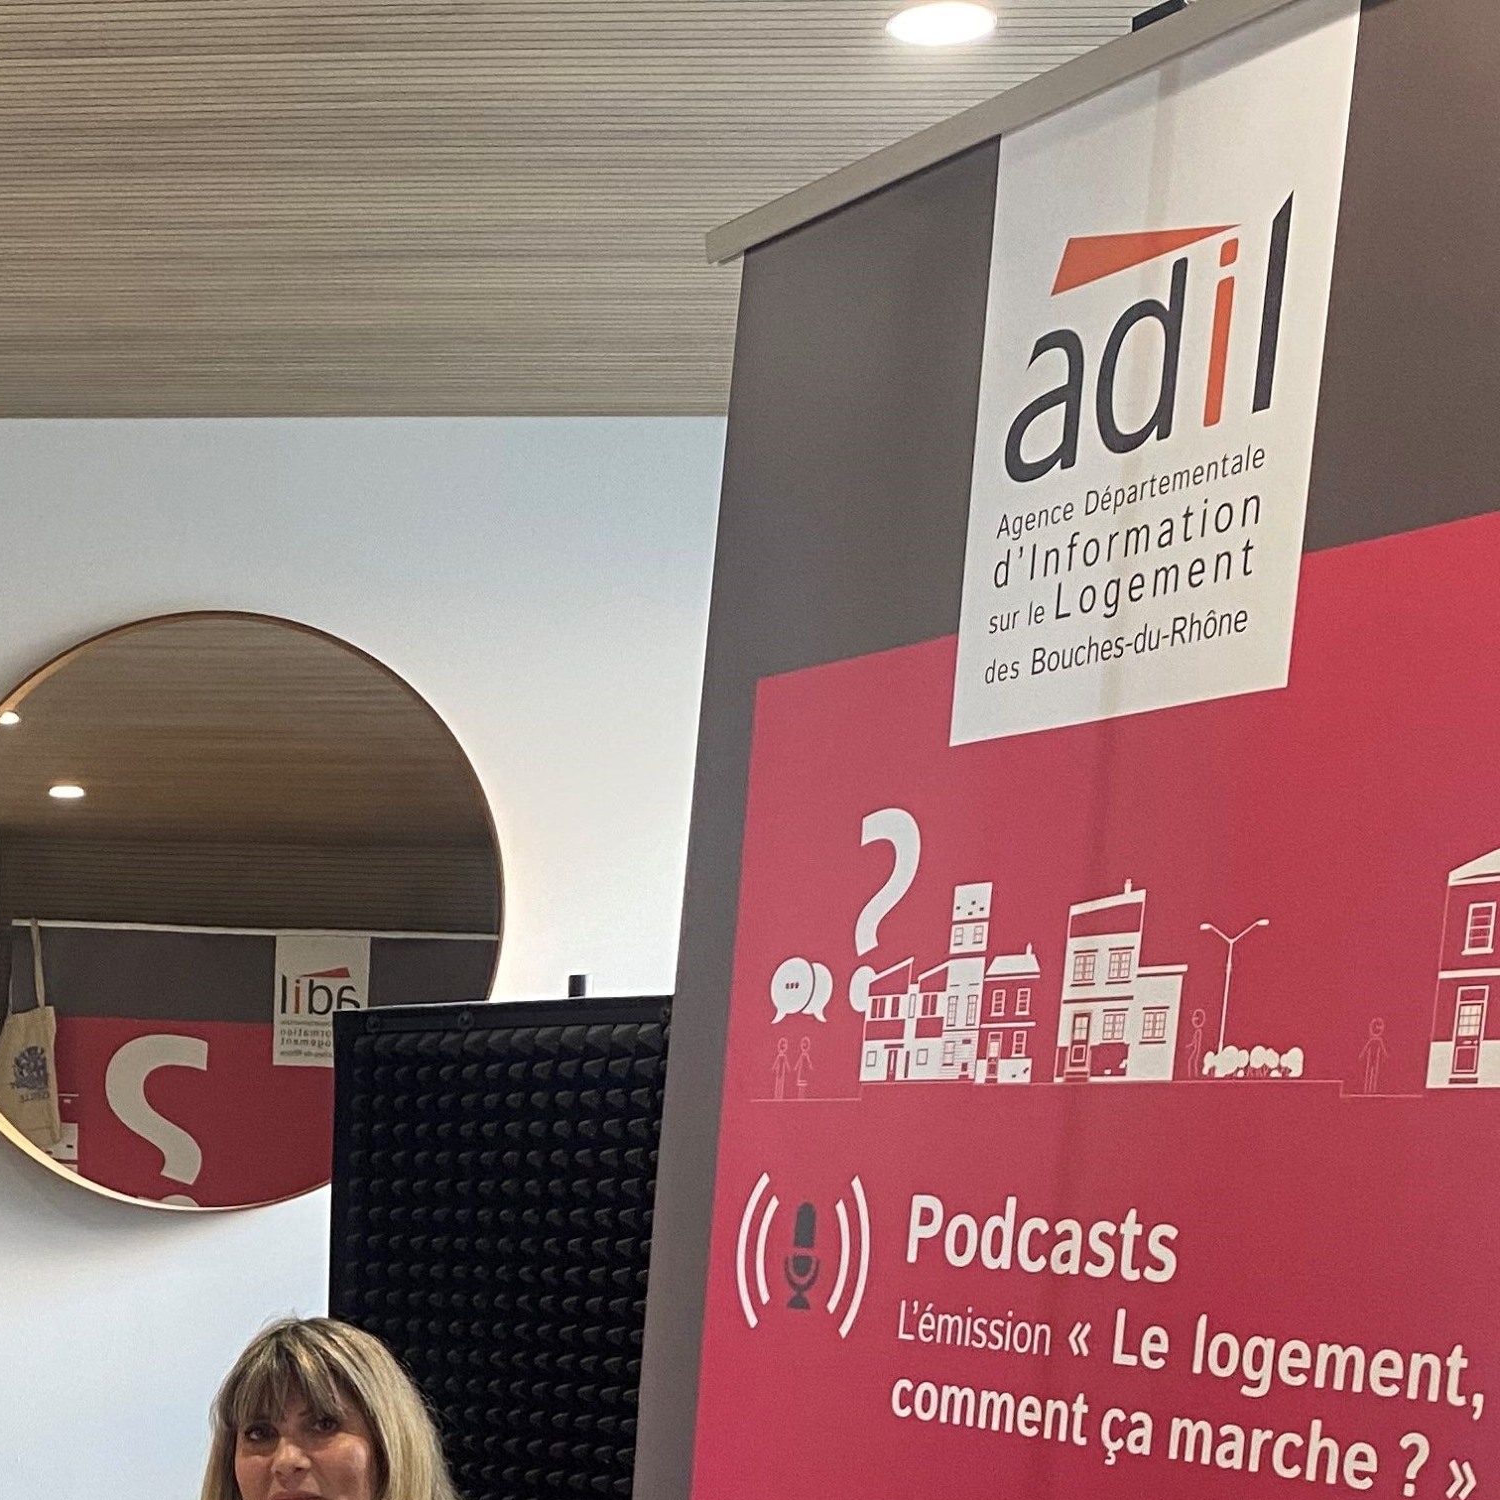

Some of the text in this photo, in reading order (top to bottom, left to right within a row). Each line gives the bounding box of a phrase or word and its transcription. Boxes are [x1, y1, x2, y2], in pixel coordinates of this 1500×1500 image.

[1004, 190, 1295, 483] adil
[996, 444, 1265, 541] Agence Départementale
[988, 538, 1254, 635] sur le Logement
[993, 495, 1261, 589] d'Information
[984, 609, 1248, 685] des Bouches-du-Rhône
[906, 1194, 1179, 1283] Podcasts
[898, 1299, 1484, 1421] L'émission « Le logement,
[891, 1378, 1477, 1500] comment ça marche ? »
